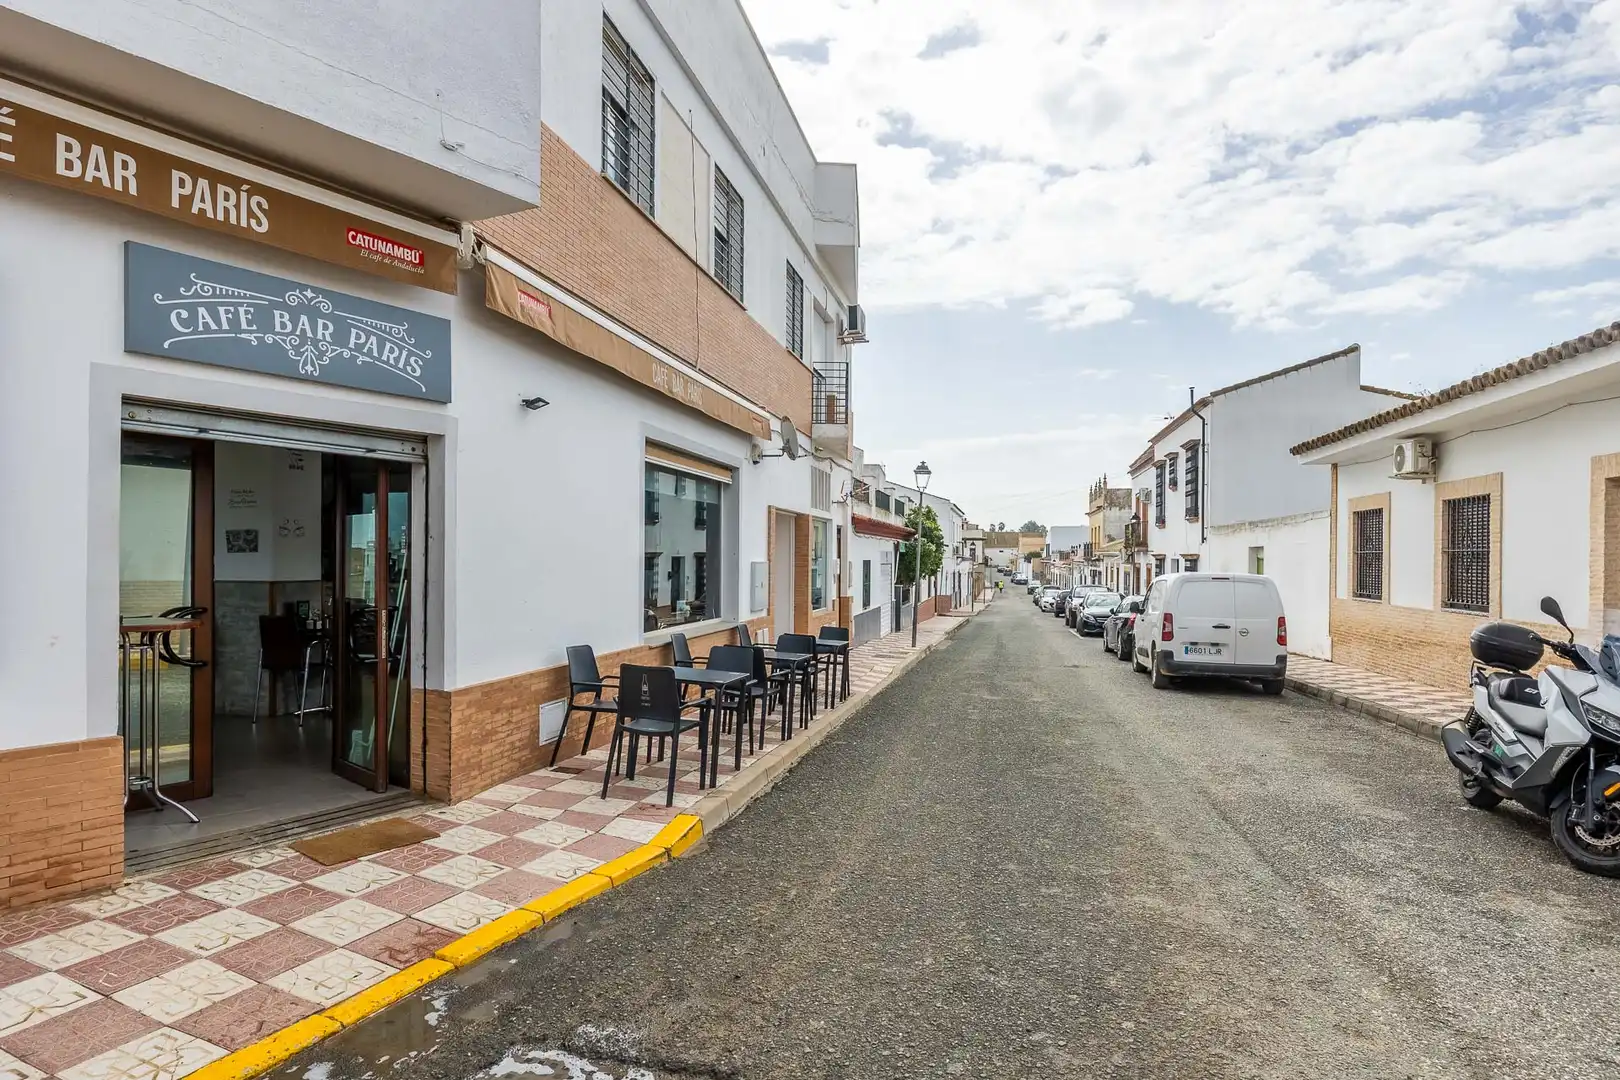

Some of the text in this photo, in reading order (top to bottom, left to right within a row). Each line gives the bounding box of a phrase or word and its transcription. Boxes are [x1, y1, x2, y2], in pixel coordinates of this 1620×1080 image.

[56, 132, 138, 197] BAR
[171, 168, 269, 234] PARÍS
[360, 249, 368, 257] El
[170, 303, 258, 333] CAFÉ
[273, 309, 334, 343] BAR
